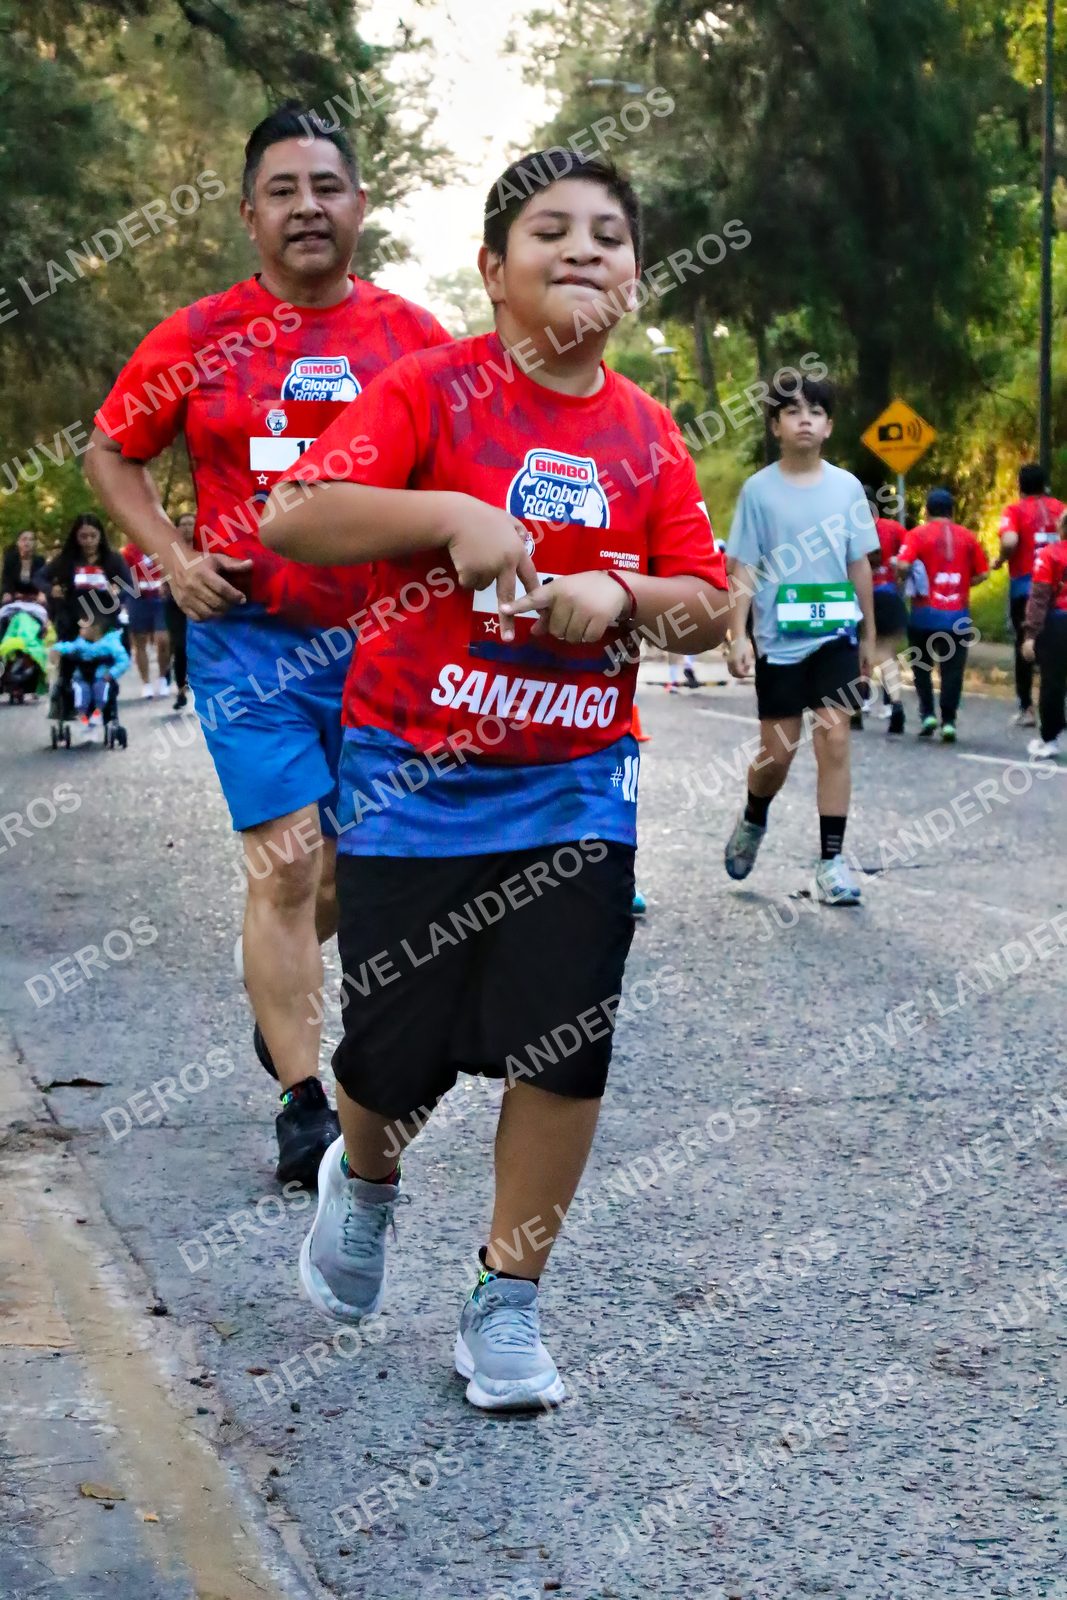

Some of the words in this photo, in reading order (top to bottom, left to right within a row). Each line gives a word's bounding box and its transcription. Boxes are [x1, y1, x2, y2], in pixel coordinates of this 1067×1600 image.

[300, 365, 342, 374] BIMBO
[302, 379, 342, 392] Global
[294, 389, 327, 401] Race
[296, 440, 316, 457] 1
[535, 459, 588, 481] BIMBO
[534, 480, 588, 507] Global
[523, 494, 566, 519] Race
[810, 604, 826, 618] 36
[431, 664, 620, 729] SANTIAGO
